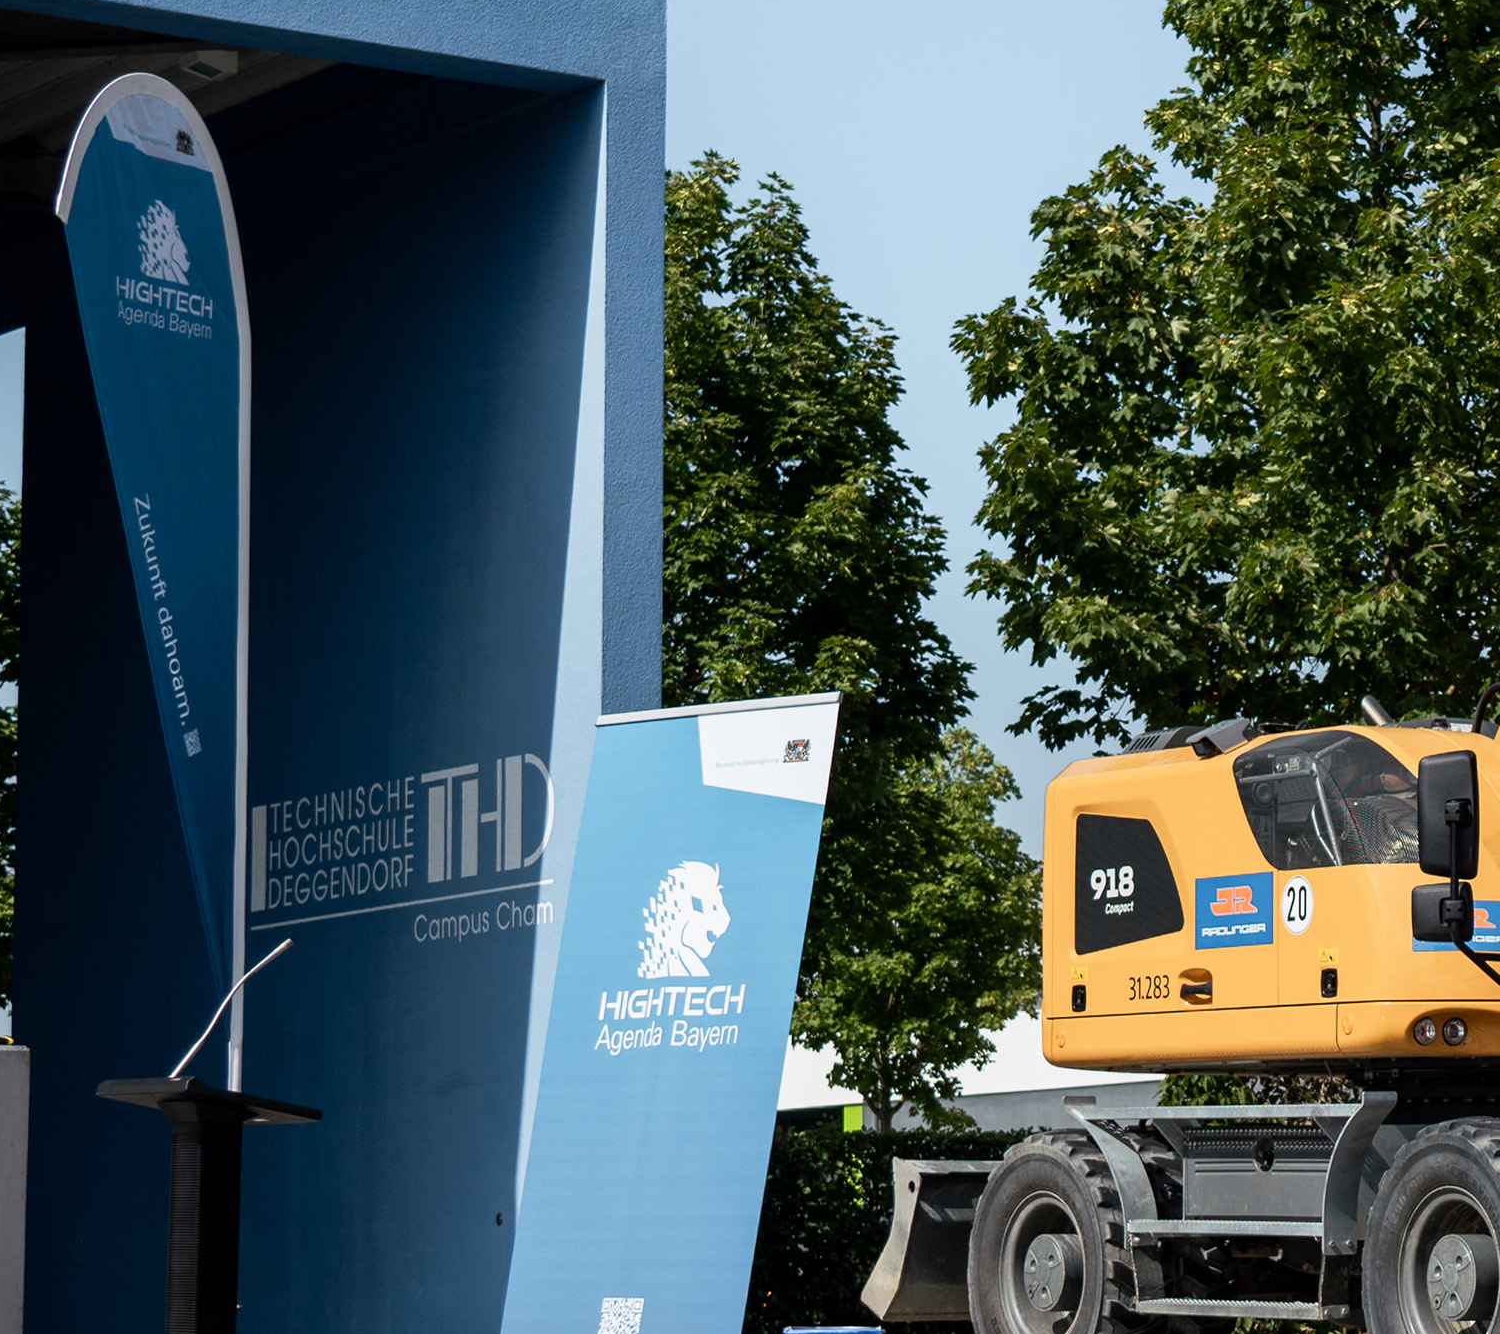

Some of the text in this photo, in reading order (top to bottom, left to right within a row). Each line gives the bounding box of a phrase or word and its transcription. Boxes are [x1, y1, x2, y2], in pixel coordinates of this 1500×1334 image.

[115, 274, 215, 320] HIGHTECH
[117, 301, 213, 341] Agenda Bayern
[134, 493, 192, 728] Zukunft dahoam.
[270, 776, 415, 834] TECHNISCHE
[421, 753, 555, 884] THD
[269, 814, 414, 871] HOCHSCHULE
[268, 854, 414, 909] DEGGENDORF
[1090, 865, 1135, 901] 918
[414, 899, 554, 943] Campus Cham
[1105, 901, 1135, 915] Compact
[1287, 885, 1307, 922] 20
[598, 983, 746, 1021] HIGHTECH
[1128, 974, 1171, 1001] 31.283
[594, 1018, 739, 1055] Agenda Bayern
